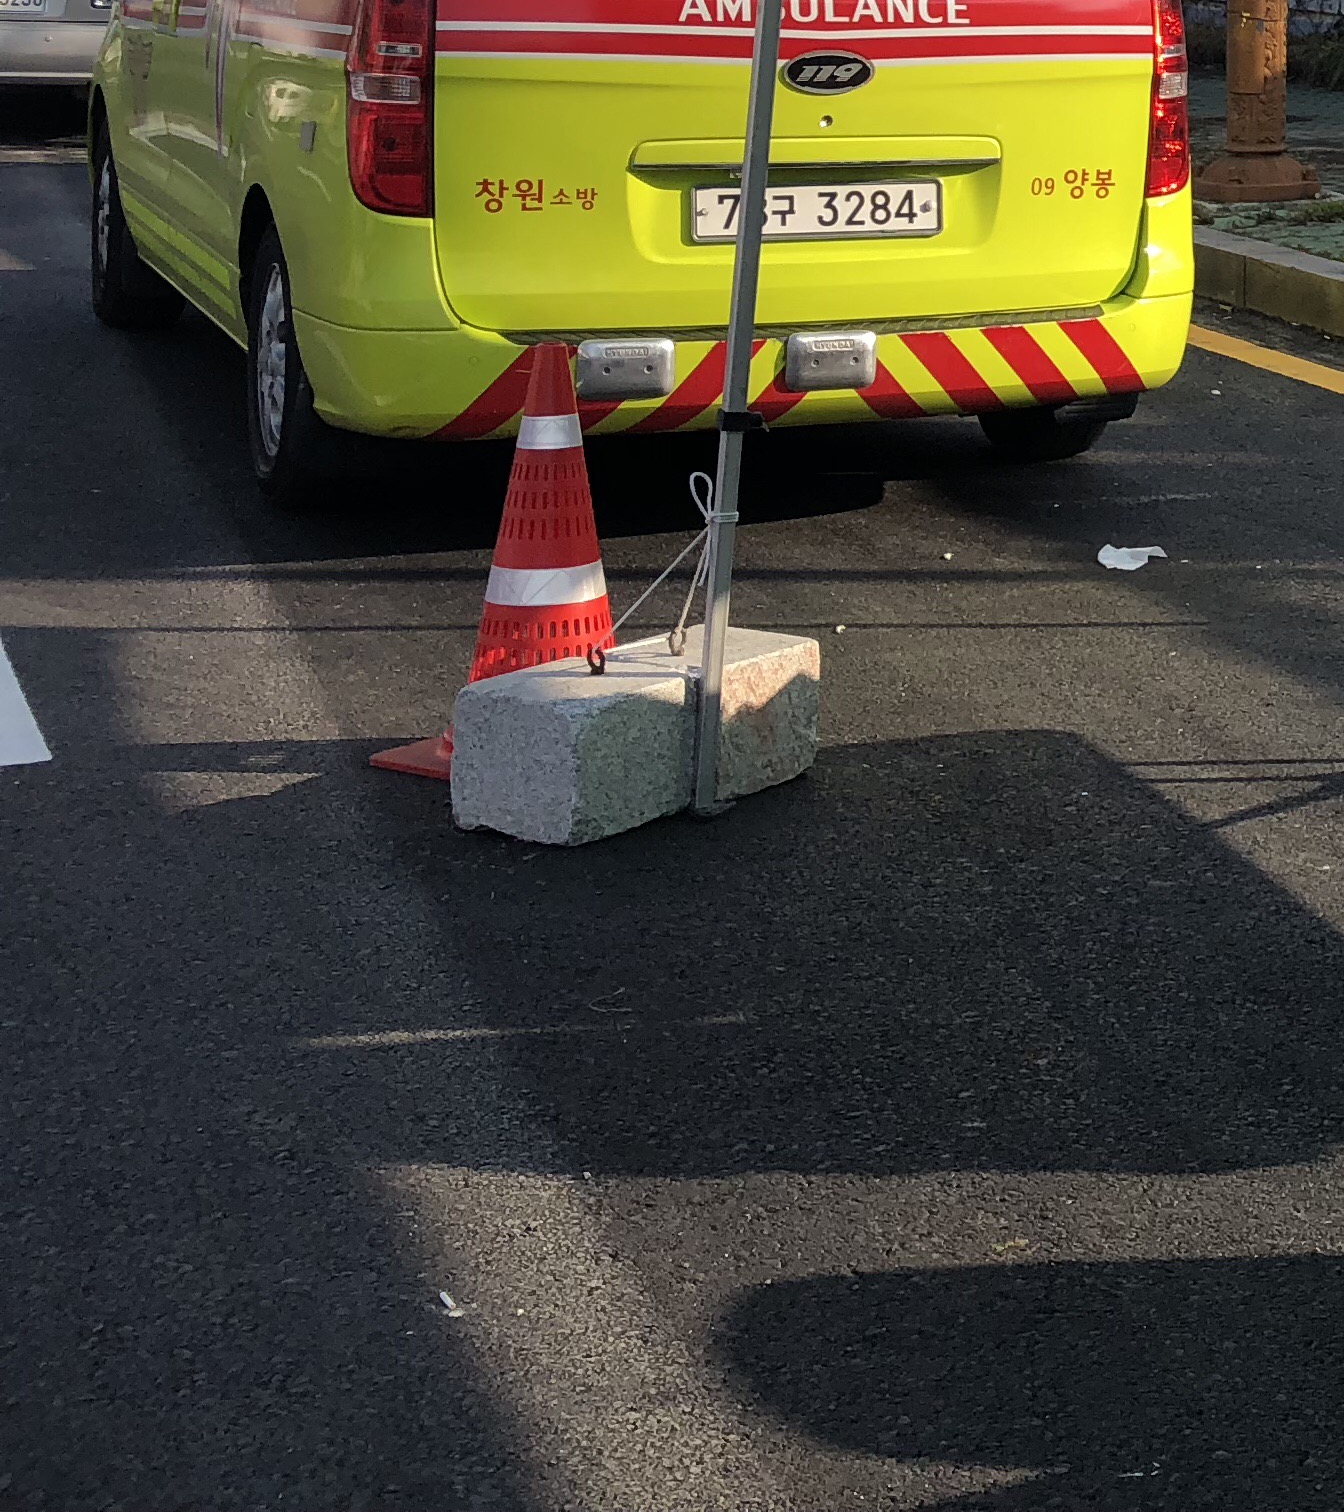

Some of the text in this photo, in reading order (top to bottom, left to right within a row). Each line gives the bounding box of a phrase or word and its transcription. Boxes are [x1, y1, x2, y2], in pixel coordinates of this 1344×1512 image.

[796, 62, 863, 82] 119
[1031, 168, 1116, 199] 09 양봉
[717, 189, 918, 230] 7구 3284
